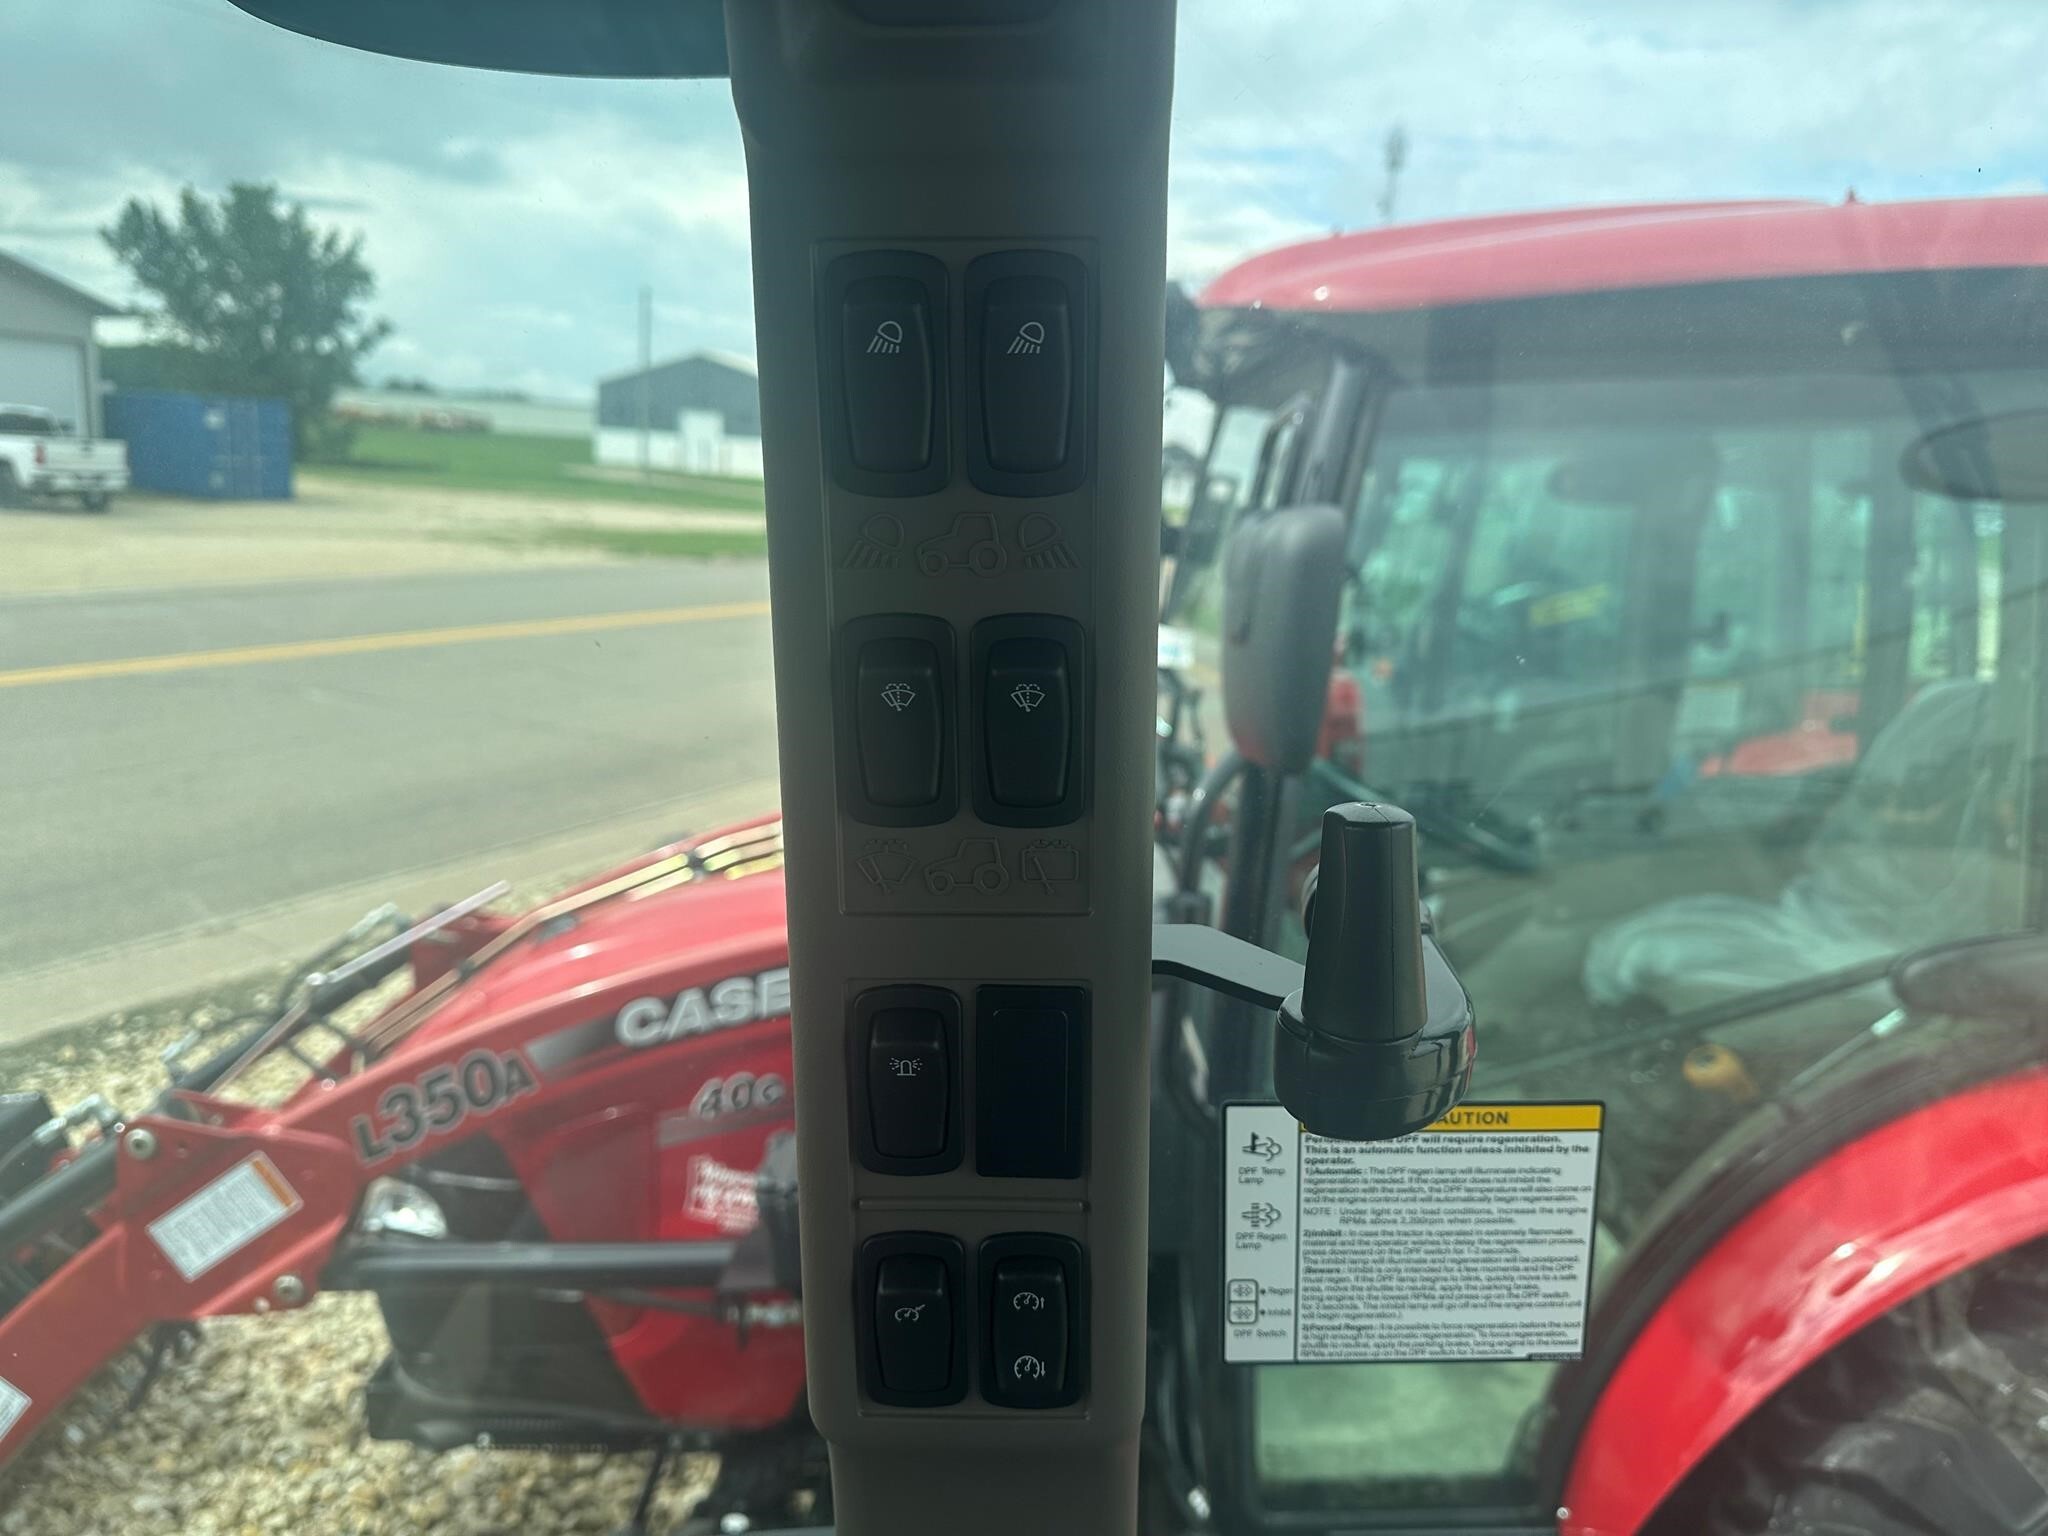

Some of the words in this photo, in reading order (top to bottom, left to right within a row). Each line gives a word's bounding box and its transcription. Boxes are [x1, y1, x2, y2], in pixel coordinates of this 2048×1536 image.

[615, 967, 791, 1047] CASE
[352, 1050, 540, 1167] L350A
[1436, 1111, 1509, 1125] AUTION
[1424, 1135, 1442, 1143] will
[1445, 1135, 1485, 1145] require
[1487, 1135, 1562, 1145] regeneration.
[1305, 1145, 1329, 1154] This
[1332, 1145, 1341, 1154] is
[1361, 1145, 1416, 1154] automatic
[1418, 1145, 1462, 1153] function
[1465, 1145, 1502, 1153] unless
[1504, 1145, 1551, 1153] inhibited
[1554, 1145, 1568, 1155] by
[1570, 1145, 1588, 1153] the
[1304, 1157, 1354, 1166] operator.
[1238, 1176, 1264, 1185] Lamp
